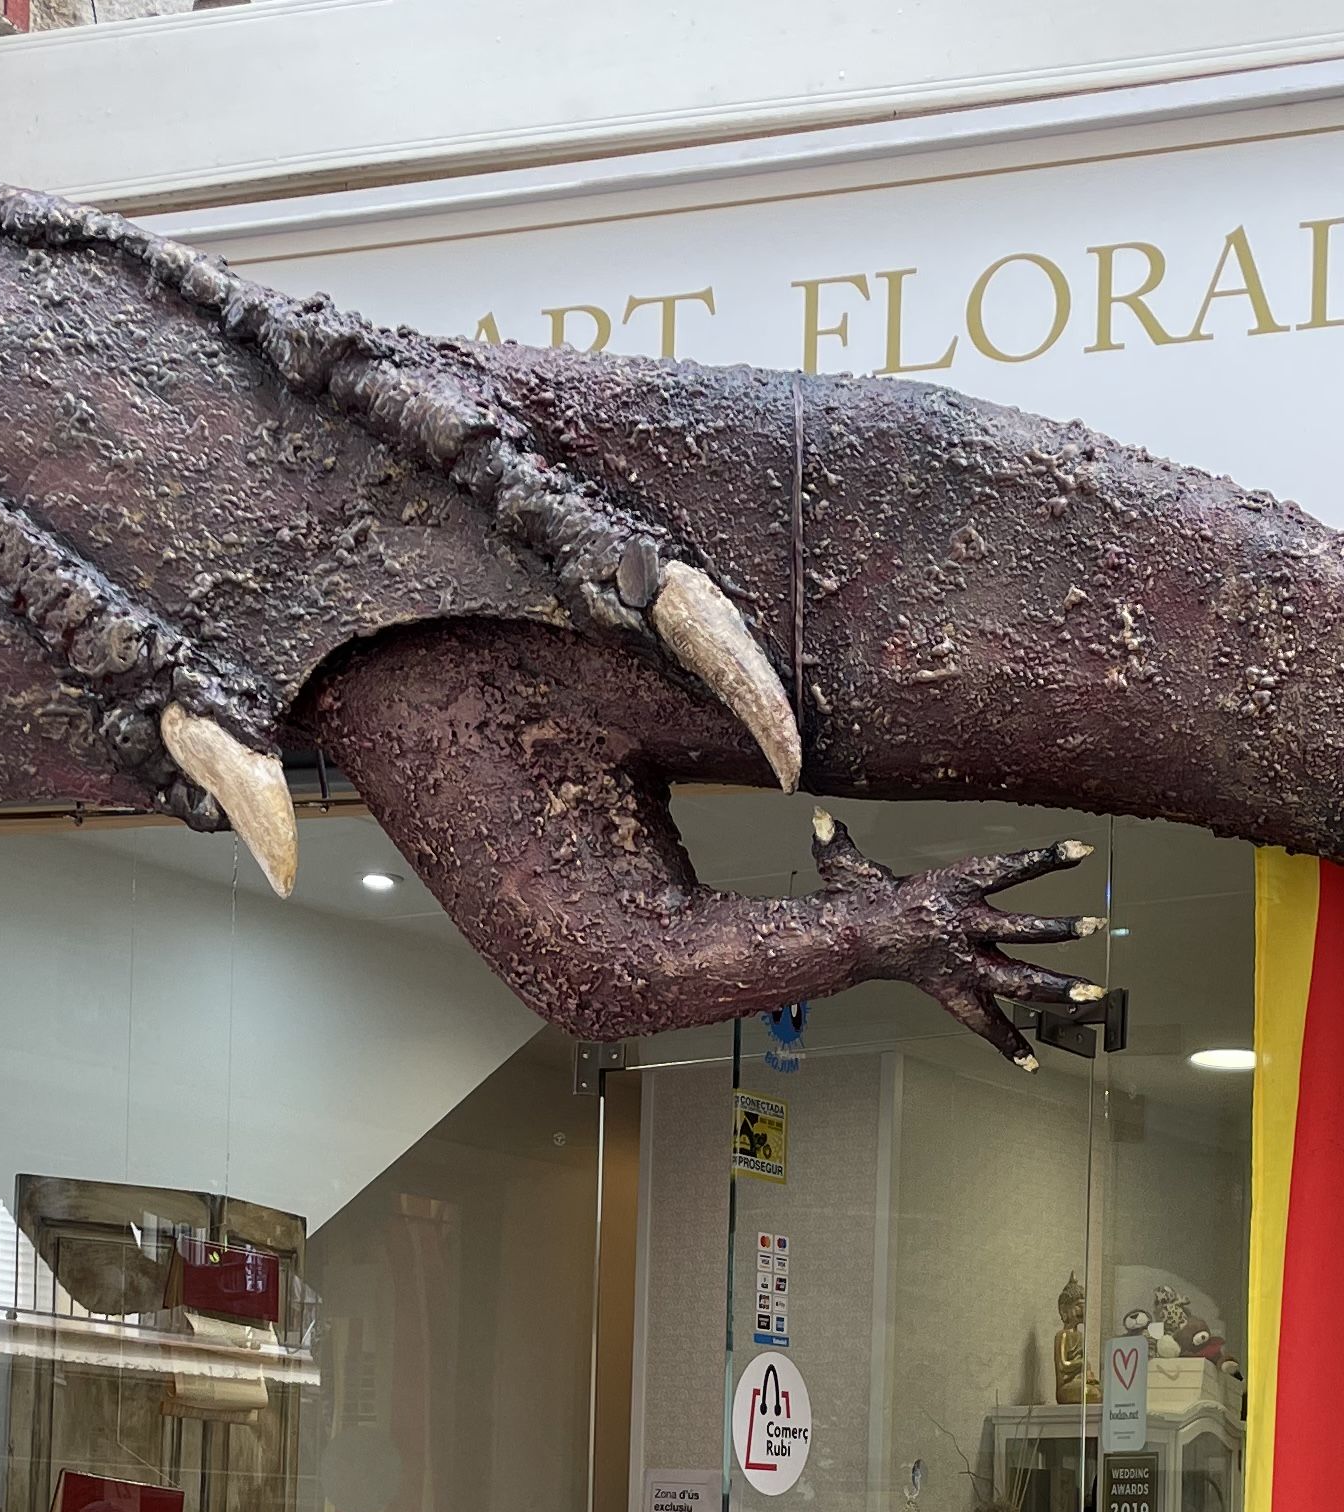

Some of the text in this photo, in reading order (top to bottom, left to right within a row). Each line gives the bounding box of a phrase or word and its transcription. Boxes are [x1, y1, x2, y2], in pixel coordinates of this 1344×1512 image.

[740, 1095, 784, 1114] CONECTADA
[738, 1156, 783, 1176] PROSEGUR
[766, 1421, 809, 1444] Comerç
[1111, 1468, 1149, 1479] WEDDING
[654, 1488, 676, 1499] Zona
[1111, 1484, 1149, 1495] AWARDS
[654, 1502, 693, 1512] exclusiu
